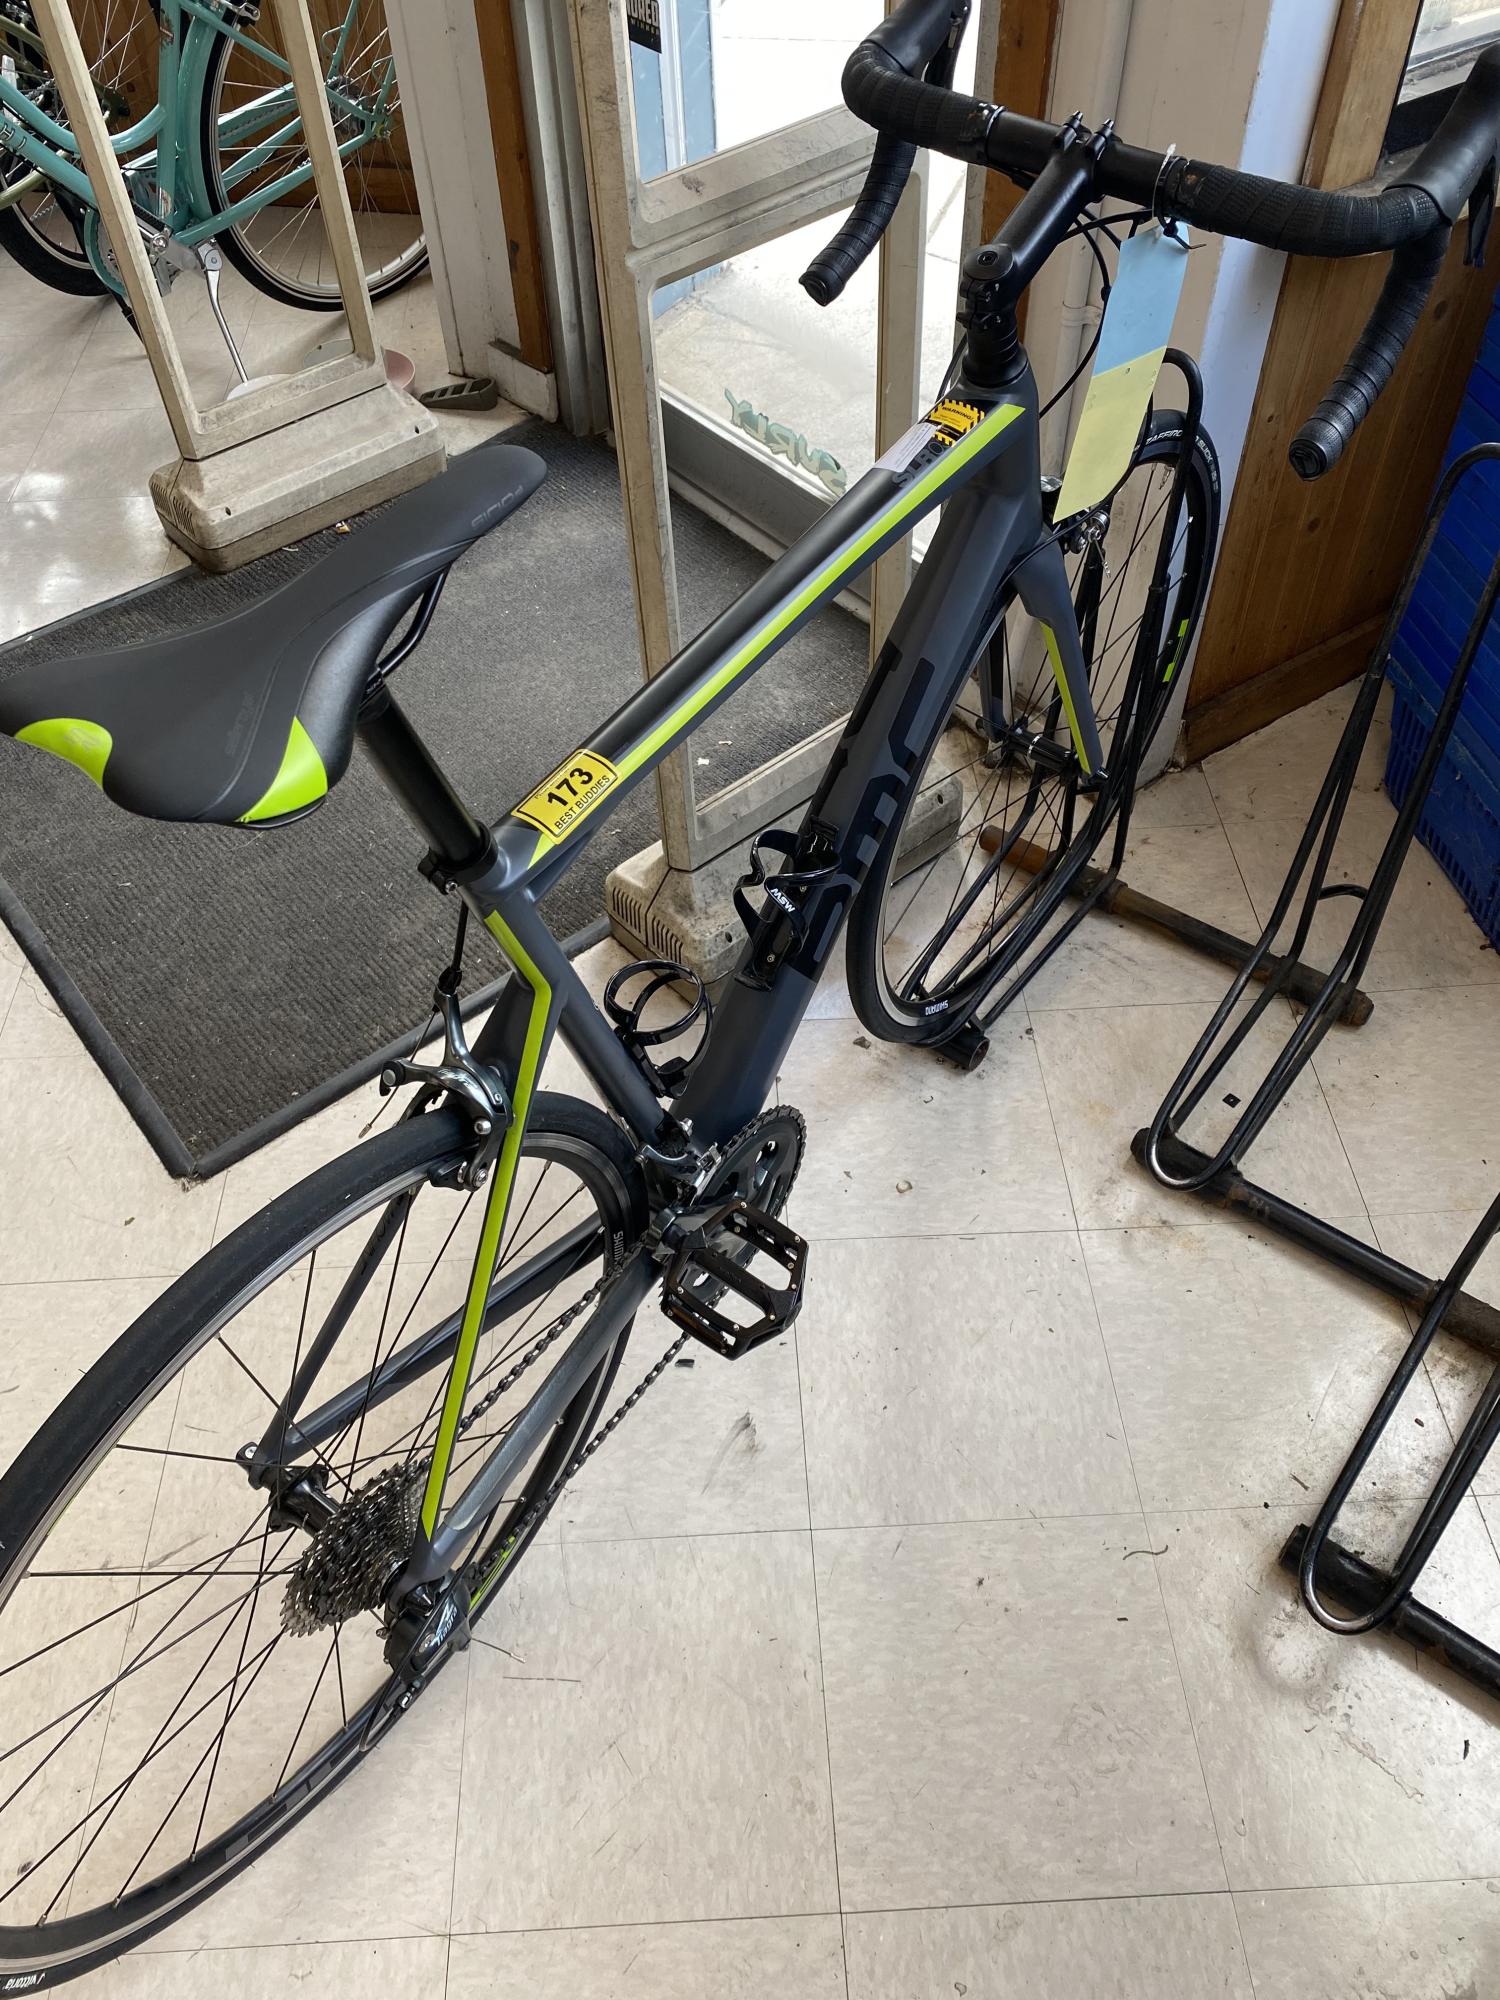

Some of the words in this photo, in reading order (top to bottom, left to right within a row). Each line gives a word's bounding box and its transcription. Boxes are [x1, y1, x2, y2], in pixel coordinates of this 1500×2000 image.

[547, 767, 593, 806] 173
[554, 806, 577, 830] BEST
[575, 774, 610, 809] BUDDIES
[771, 888, 796, 912] MSW
